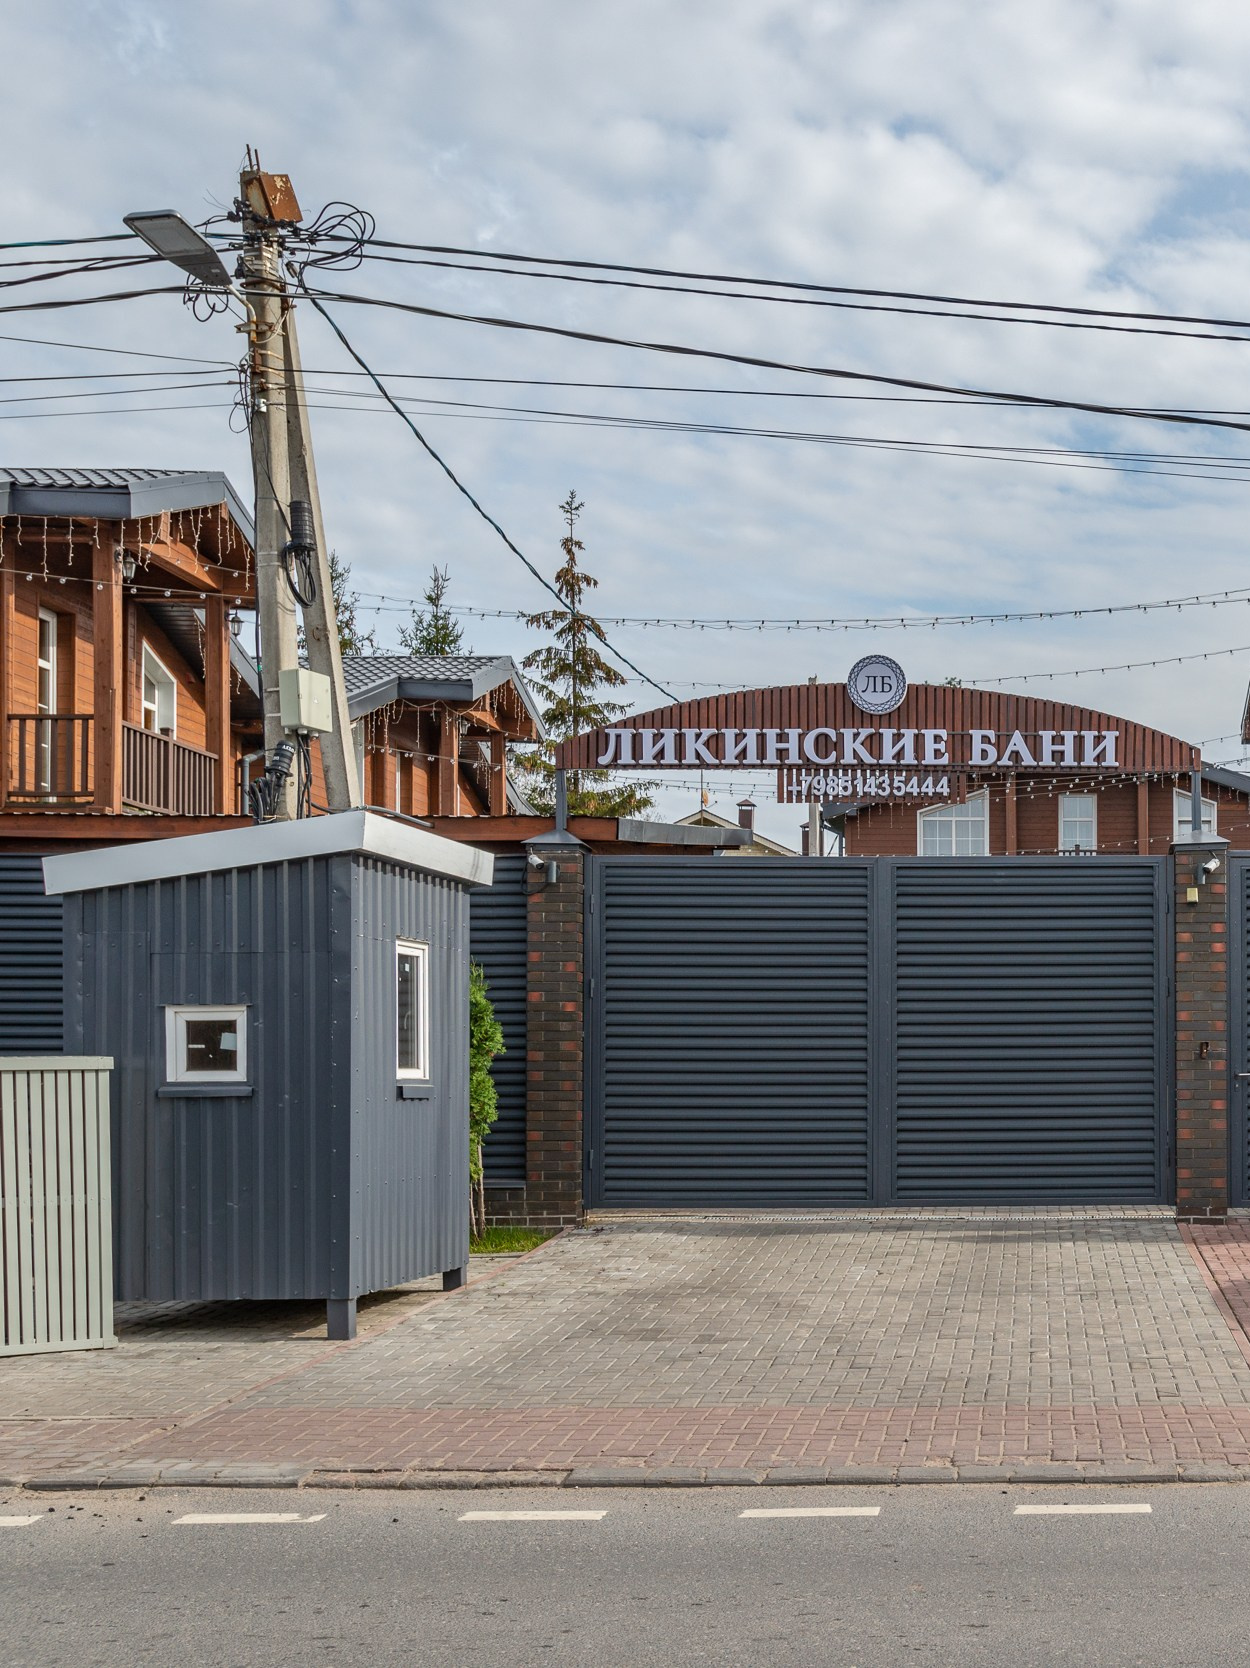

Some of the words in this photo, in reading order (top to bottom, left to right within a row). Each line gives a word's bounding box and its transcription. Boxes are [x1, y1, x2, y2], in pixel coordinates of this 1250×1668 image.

[861, 675, 893, 694] ЛБ
[597, 727, 949, 766] ЛИКИНСКИЕ
[968, 729, 1120, 767] БАНИ
[787, 775, 950, 797] +79851435444
